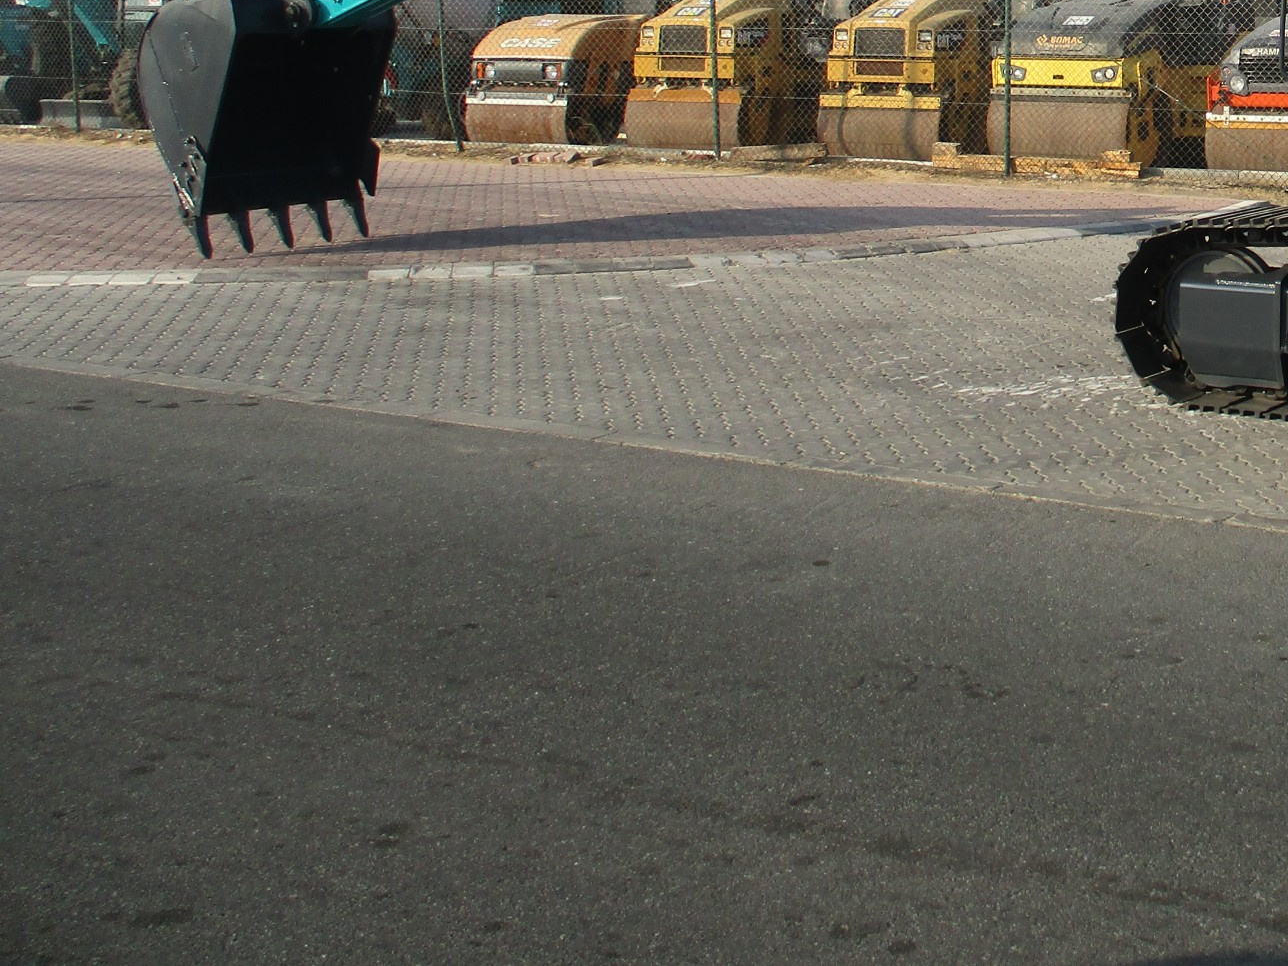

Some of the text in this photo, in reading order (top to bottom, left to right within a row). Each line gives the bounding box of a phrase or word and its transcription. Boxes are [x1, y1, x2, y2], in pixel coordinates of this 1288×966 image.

[676, 7, 708, 16] CAT
[873, 8, 905, 17] CAT
[500, 37, 562, 48] CASE
